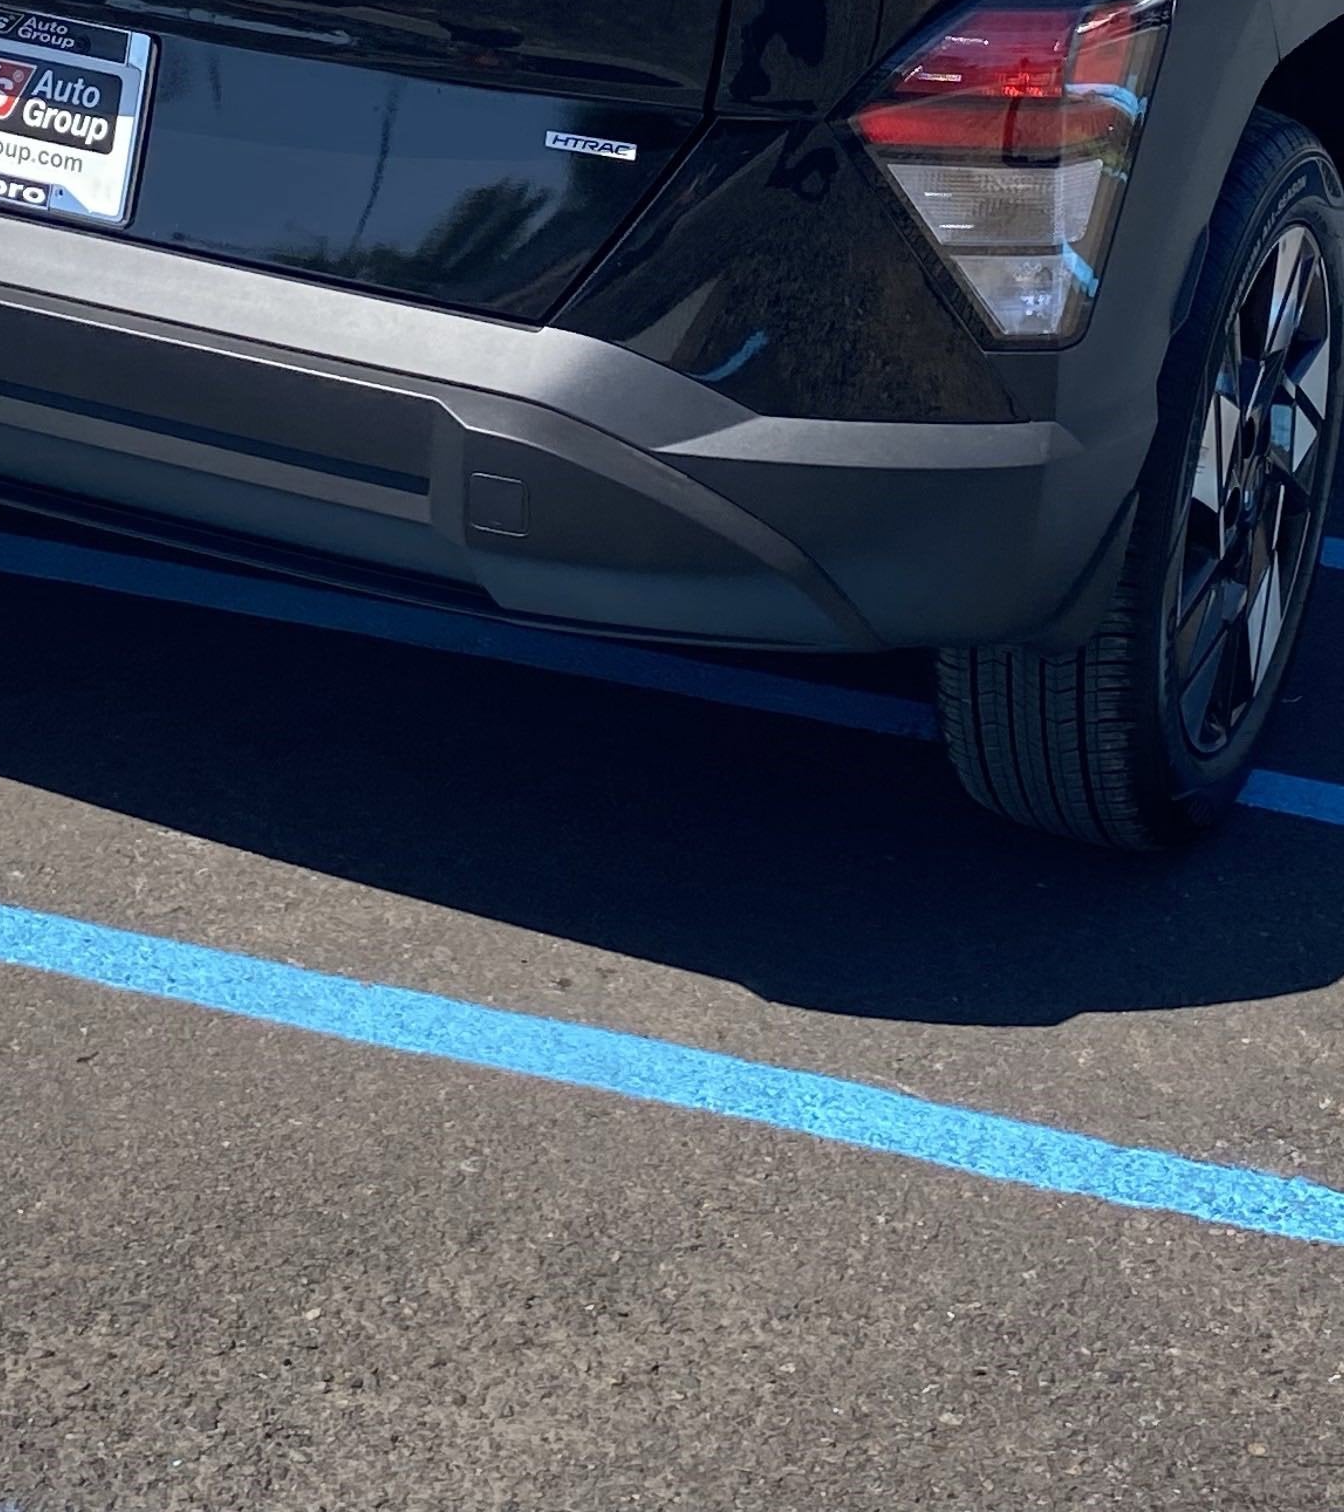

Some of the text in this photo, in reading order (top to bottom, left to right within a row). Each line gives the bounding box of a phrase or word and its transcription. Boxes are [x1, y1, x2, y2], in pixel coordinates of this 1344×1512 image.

[24, 16, 68, 35] Auto
[17, 26, 75, 50] Group
[31, 69, 101, 109] Auto
[22, 97, 109, 145] Group
[552, 134, 631, 156] HTRAC
